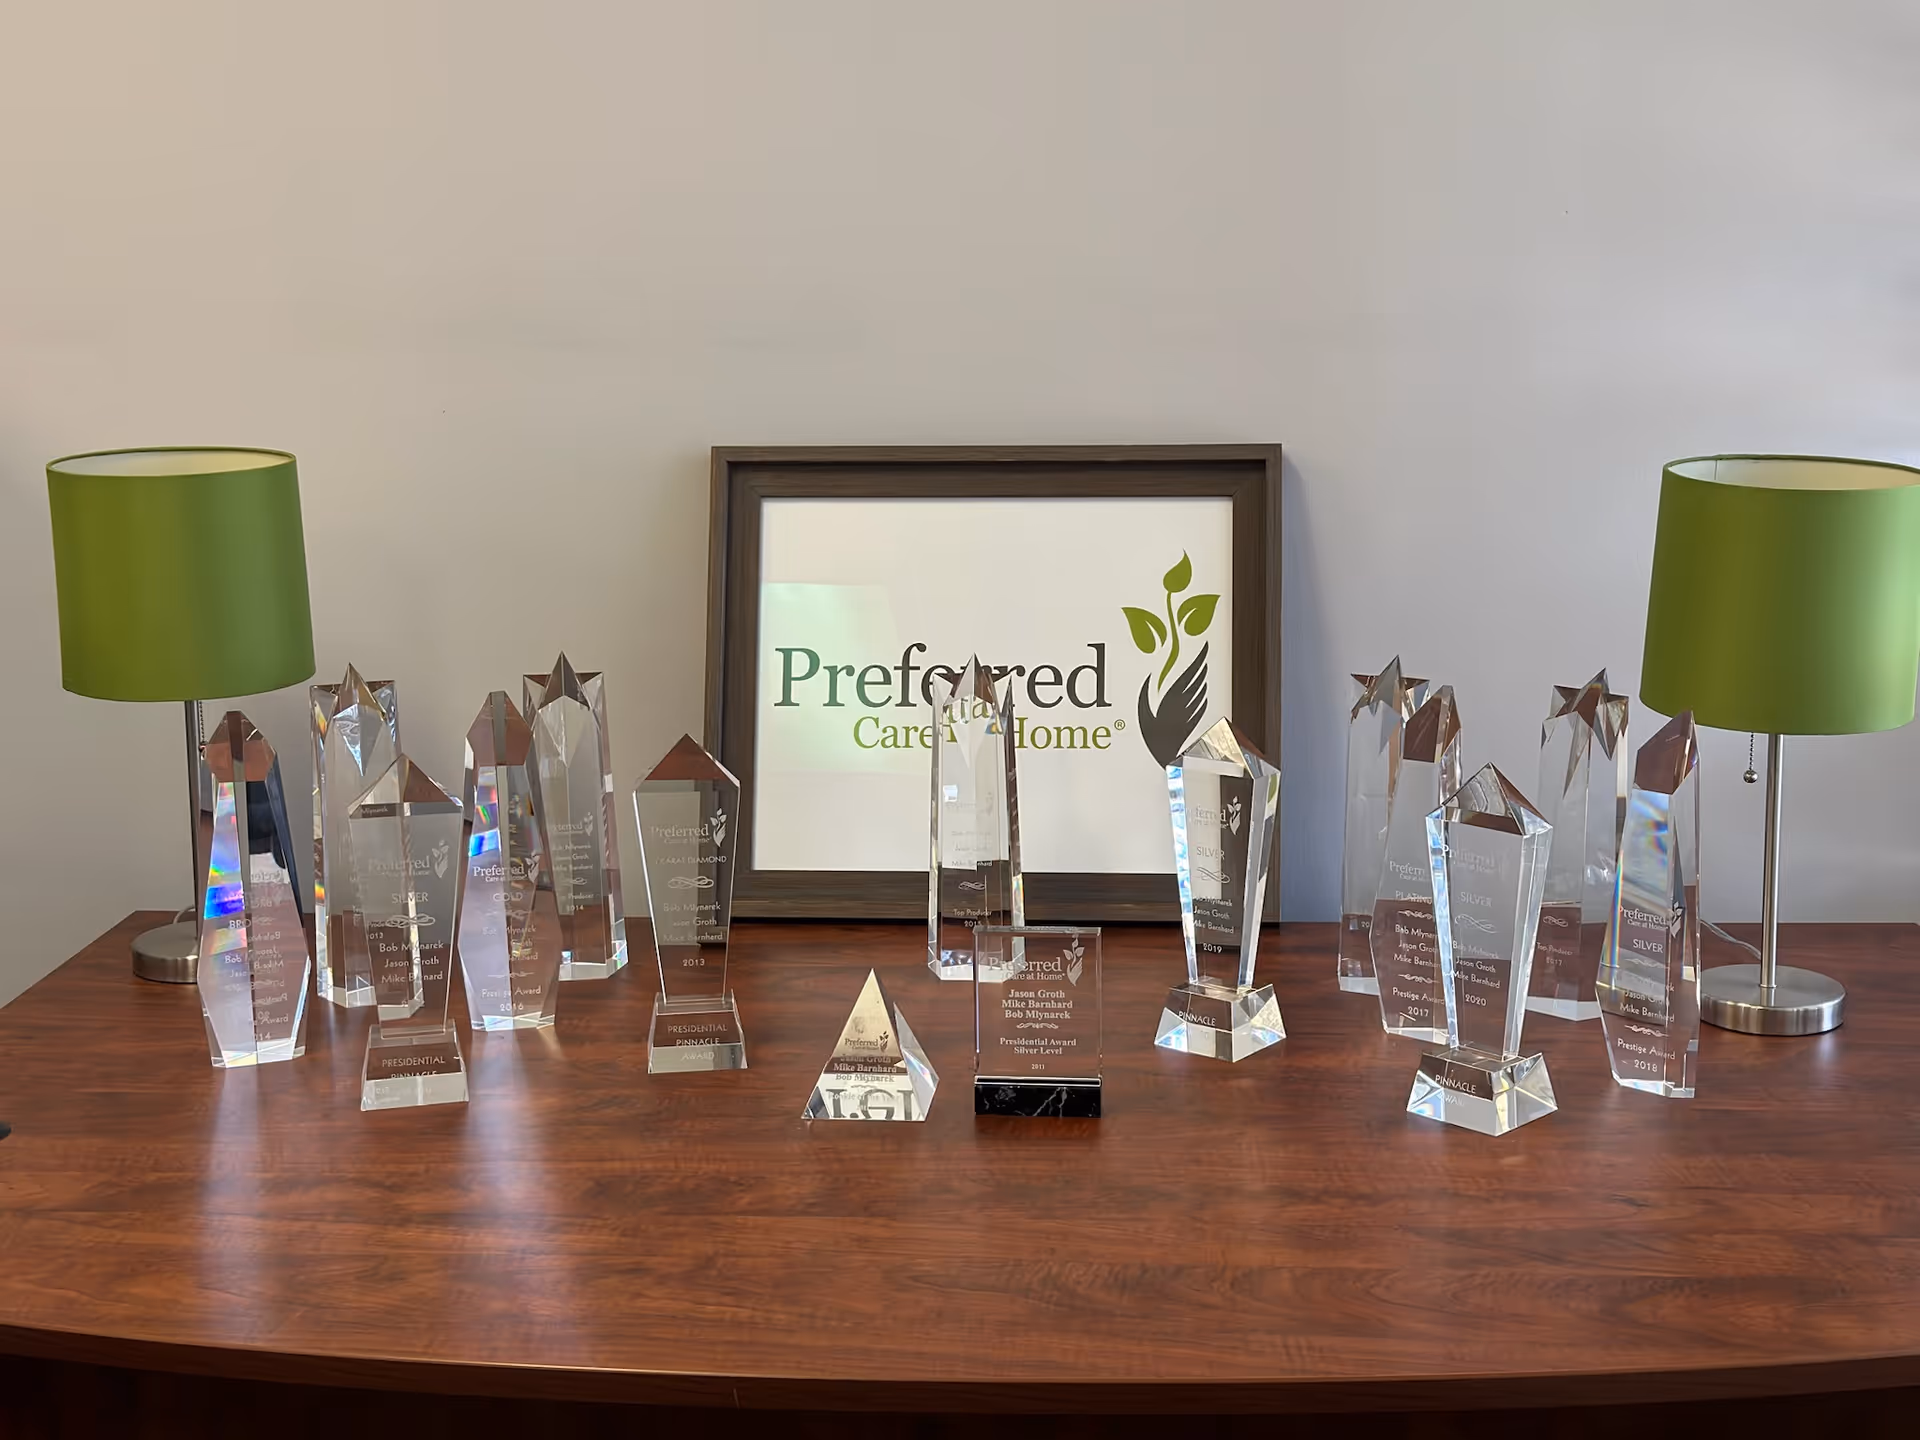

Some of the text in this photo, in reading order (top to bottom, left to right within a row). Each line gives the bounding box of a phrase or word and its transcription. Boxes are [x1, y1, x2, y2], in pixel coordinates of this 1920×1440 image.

[773, 643, 1111, 708] Prefered
[853, 716, 933, 749] Care
[473, 864, 525, 877] Prefered
[1395, 890, 1432, 905] PLATINU
[1460, 891, 1492, 907] SILVER
[693, 916, 717, 926] Groth
[380, 943, 398, 952] Bob
[1203, 942, 1222, 953] 2019
[1633, 938, 1663, 953] SILVER
[385, 958, 409, 968] Jason
[683, 958, 705, 967] 2013
[988, 957, 1062, 971] Preerred
[1414, 956, 1441, 968] Barnhar
[1456, 956, 1496, 973] Jason Groth
[382, 974, 405, 984] Mike
[1471, 973, 1501, 989] Barnhard
[515, 985, 541, 996] Award
[1008, 989, 1065, 998] Jason Groth
[1392, 986, 1419, 1001] Prestige
[1625, 989, 1645, 1001] Jason
[1001, 999, 1073, 1009] Mike Barnhard
[1465, 994, 1487, 1007] 2020
[500, 1003, 524, 1012] 2016
[1408, 1006, 1429, 1017] 2017
[1620, 1002, 1640, 1014] Mike
[1005, 1009, 1071, 1020] Bob Mlynarek
[1178, 1010, 1216, 1026] PINNACLE
[668, 1024, 727, 1034] PRESIDENTIAL
[676, 1038, 720, 1047] PINNACLE
[1000, 1037, 1077, 1046] Presidential Award
[1014, 1046, 1062, 1055] Silver Level
[1617, 1038, 1676, 1060] Prestige Award
[382, 1056, 445, 1068] PRESIDENTIAL
[833, 1063, 855, 1071] Mike
[1633, 1059, 1657, 1072] 2018
[1435, 1074, 1477, 1094] PINNACLE
